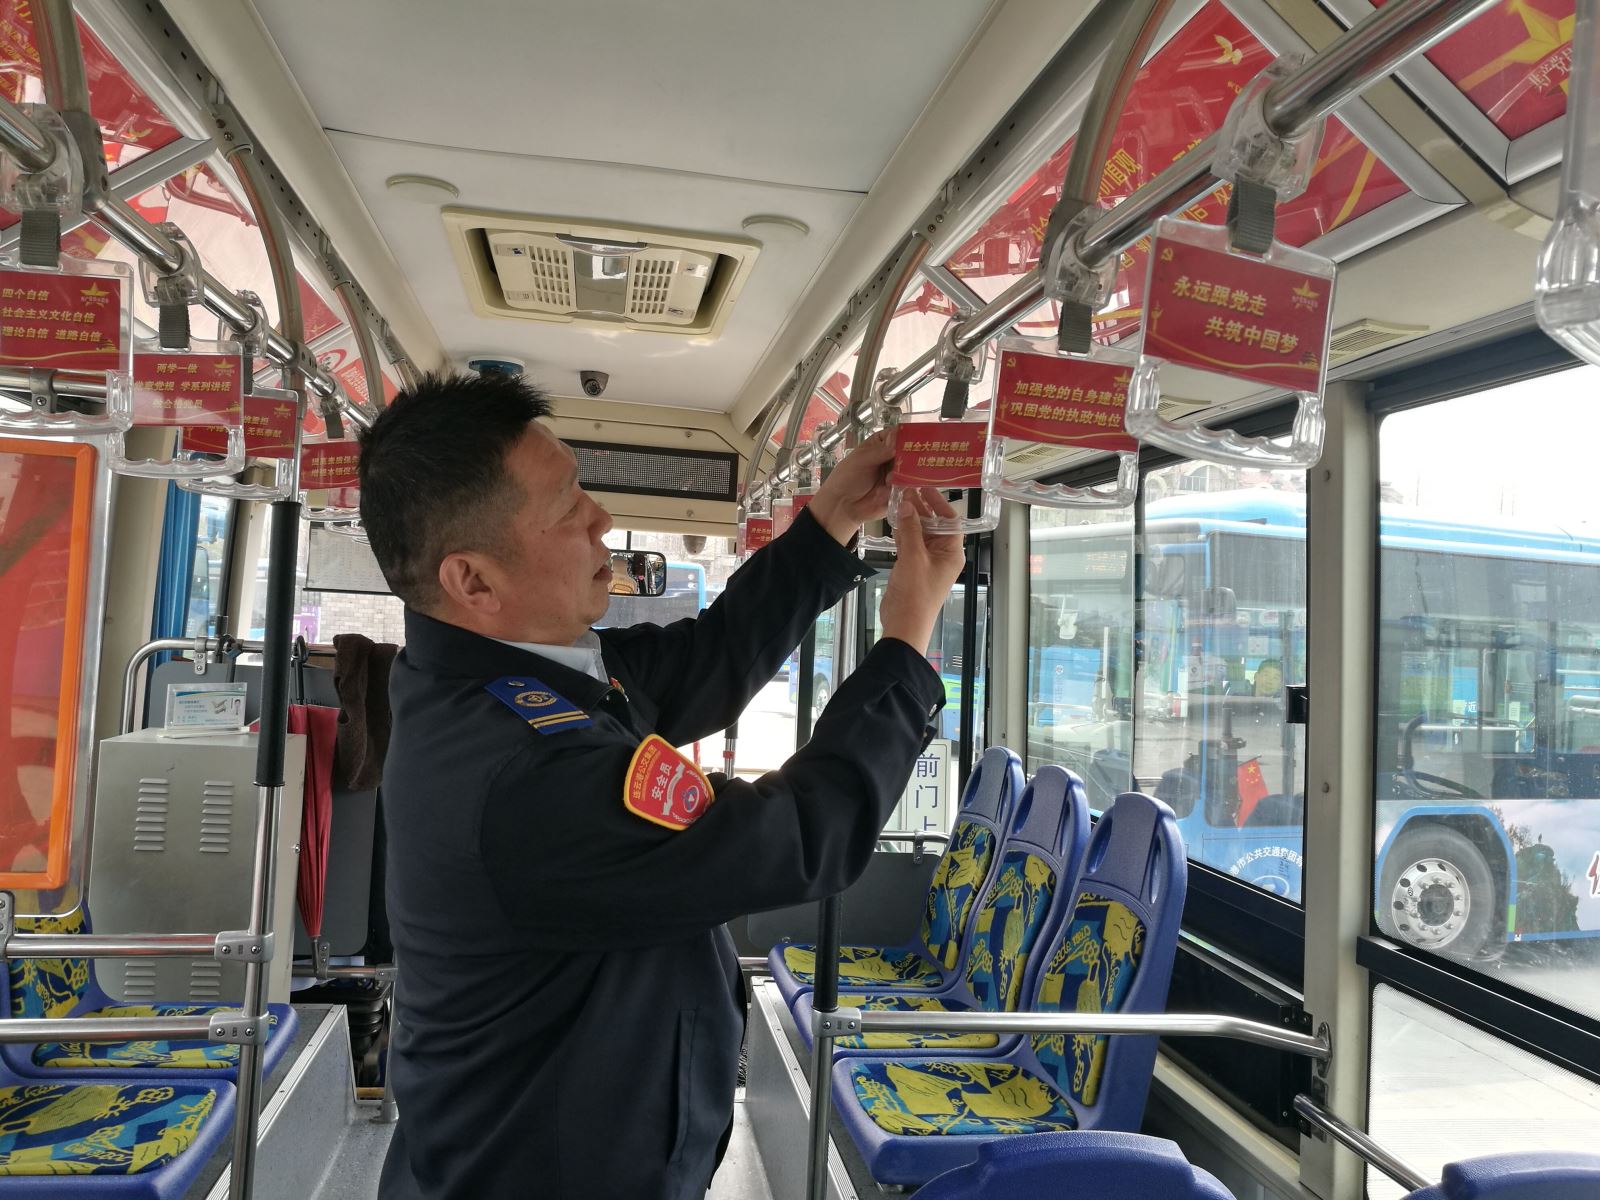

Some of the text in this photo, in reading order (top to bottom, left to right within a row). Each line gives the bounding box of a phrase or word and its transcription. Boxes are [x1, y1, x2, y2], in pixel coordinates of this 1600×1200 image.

[2, 288, 50, 301] 四个自信
[1172, 275, 1267, 316] 永远跟党走
[1, 306, 96, 323] 社会主义文化自信
[1, 326, 102, 342] 理论自信 道路自信
[1204, 315, 1299, 354] 共筑中国梦
[156, 363, 198, 374] 两学一做
[1013, 380, 1126, 408] 加强党的自身建设
[1009, 401, 1122, 428] 巩固党的执政地位
[651, 762, 673, 801] 安全员
